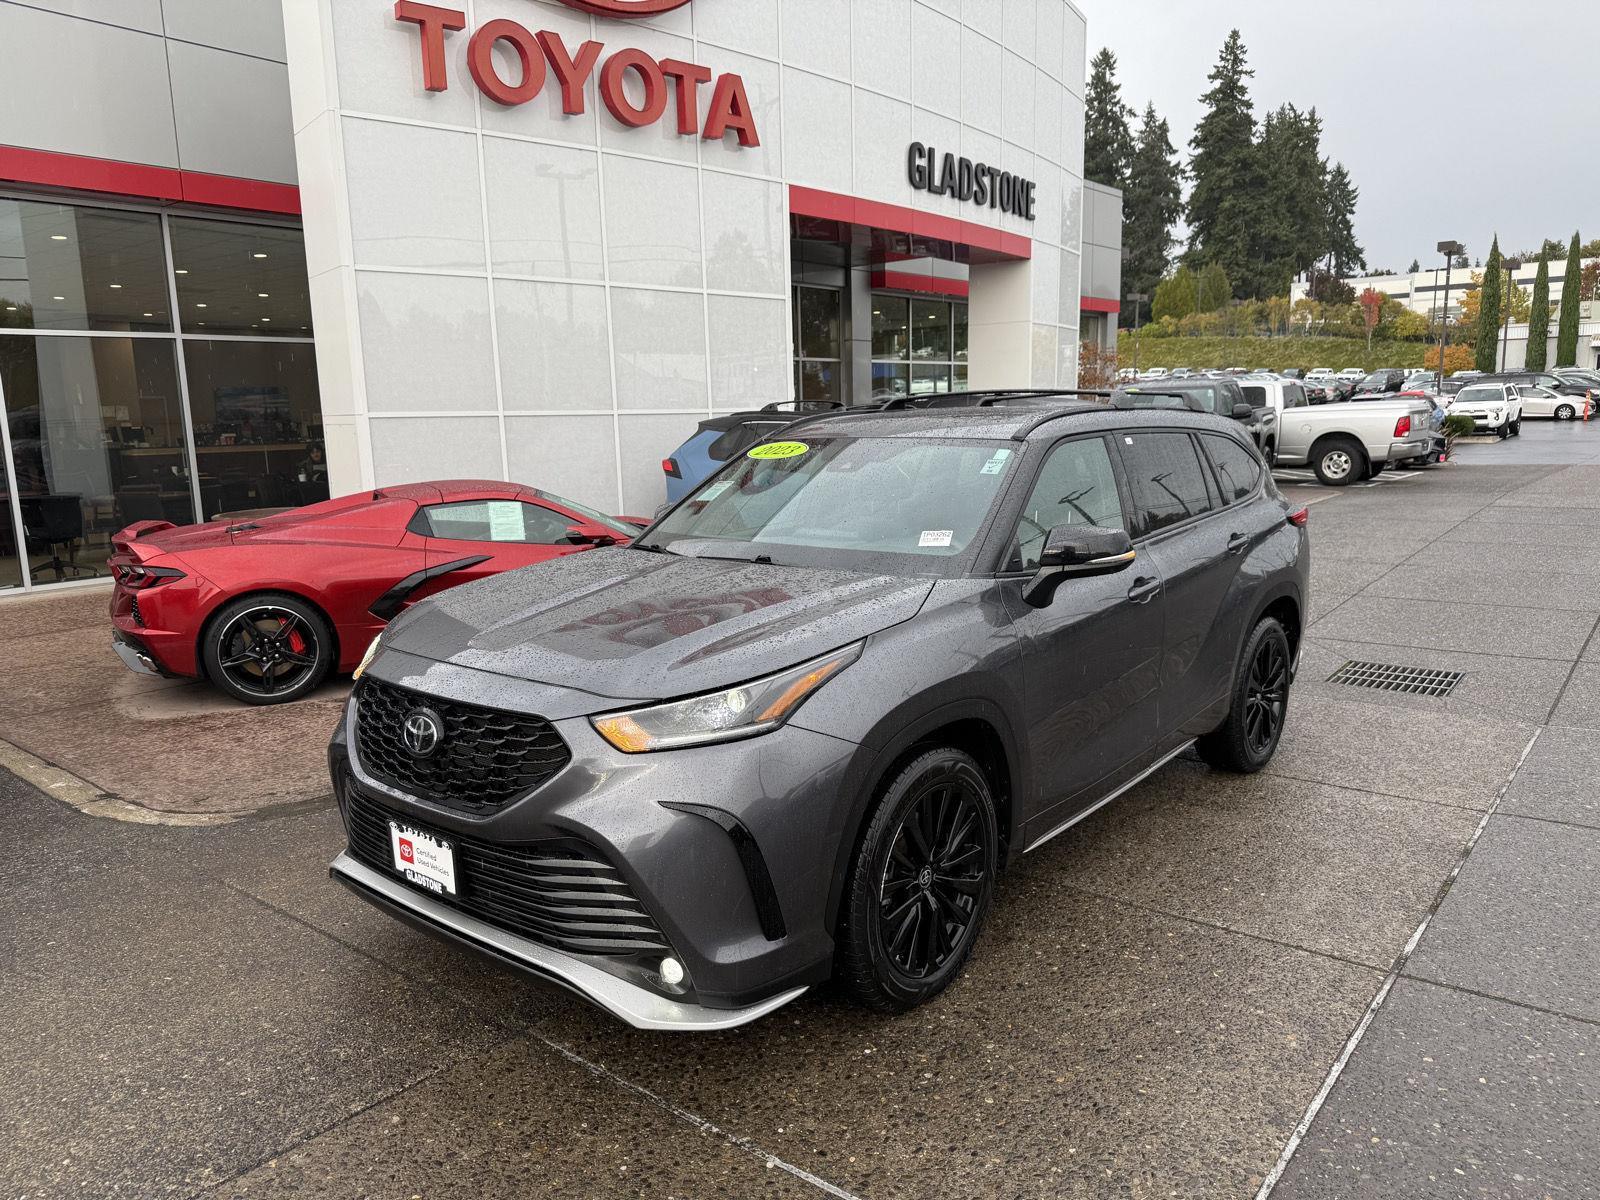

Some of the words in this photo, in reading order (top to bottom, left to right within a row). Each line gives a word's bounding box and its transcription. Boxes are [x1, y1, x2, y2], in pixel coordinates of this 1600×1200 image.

[394, 0, 760, 147] TOYOTA
[908, 142, 1036, 220] GLADSTONE
[753, 445, 802, 456] 2023
[416, 847, 437, 861] Certified
[417, 857, 430, 867] Used
[430, 862, 450, 877] Vehicles
[406, 869, 443, 894] GLADSTONE
